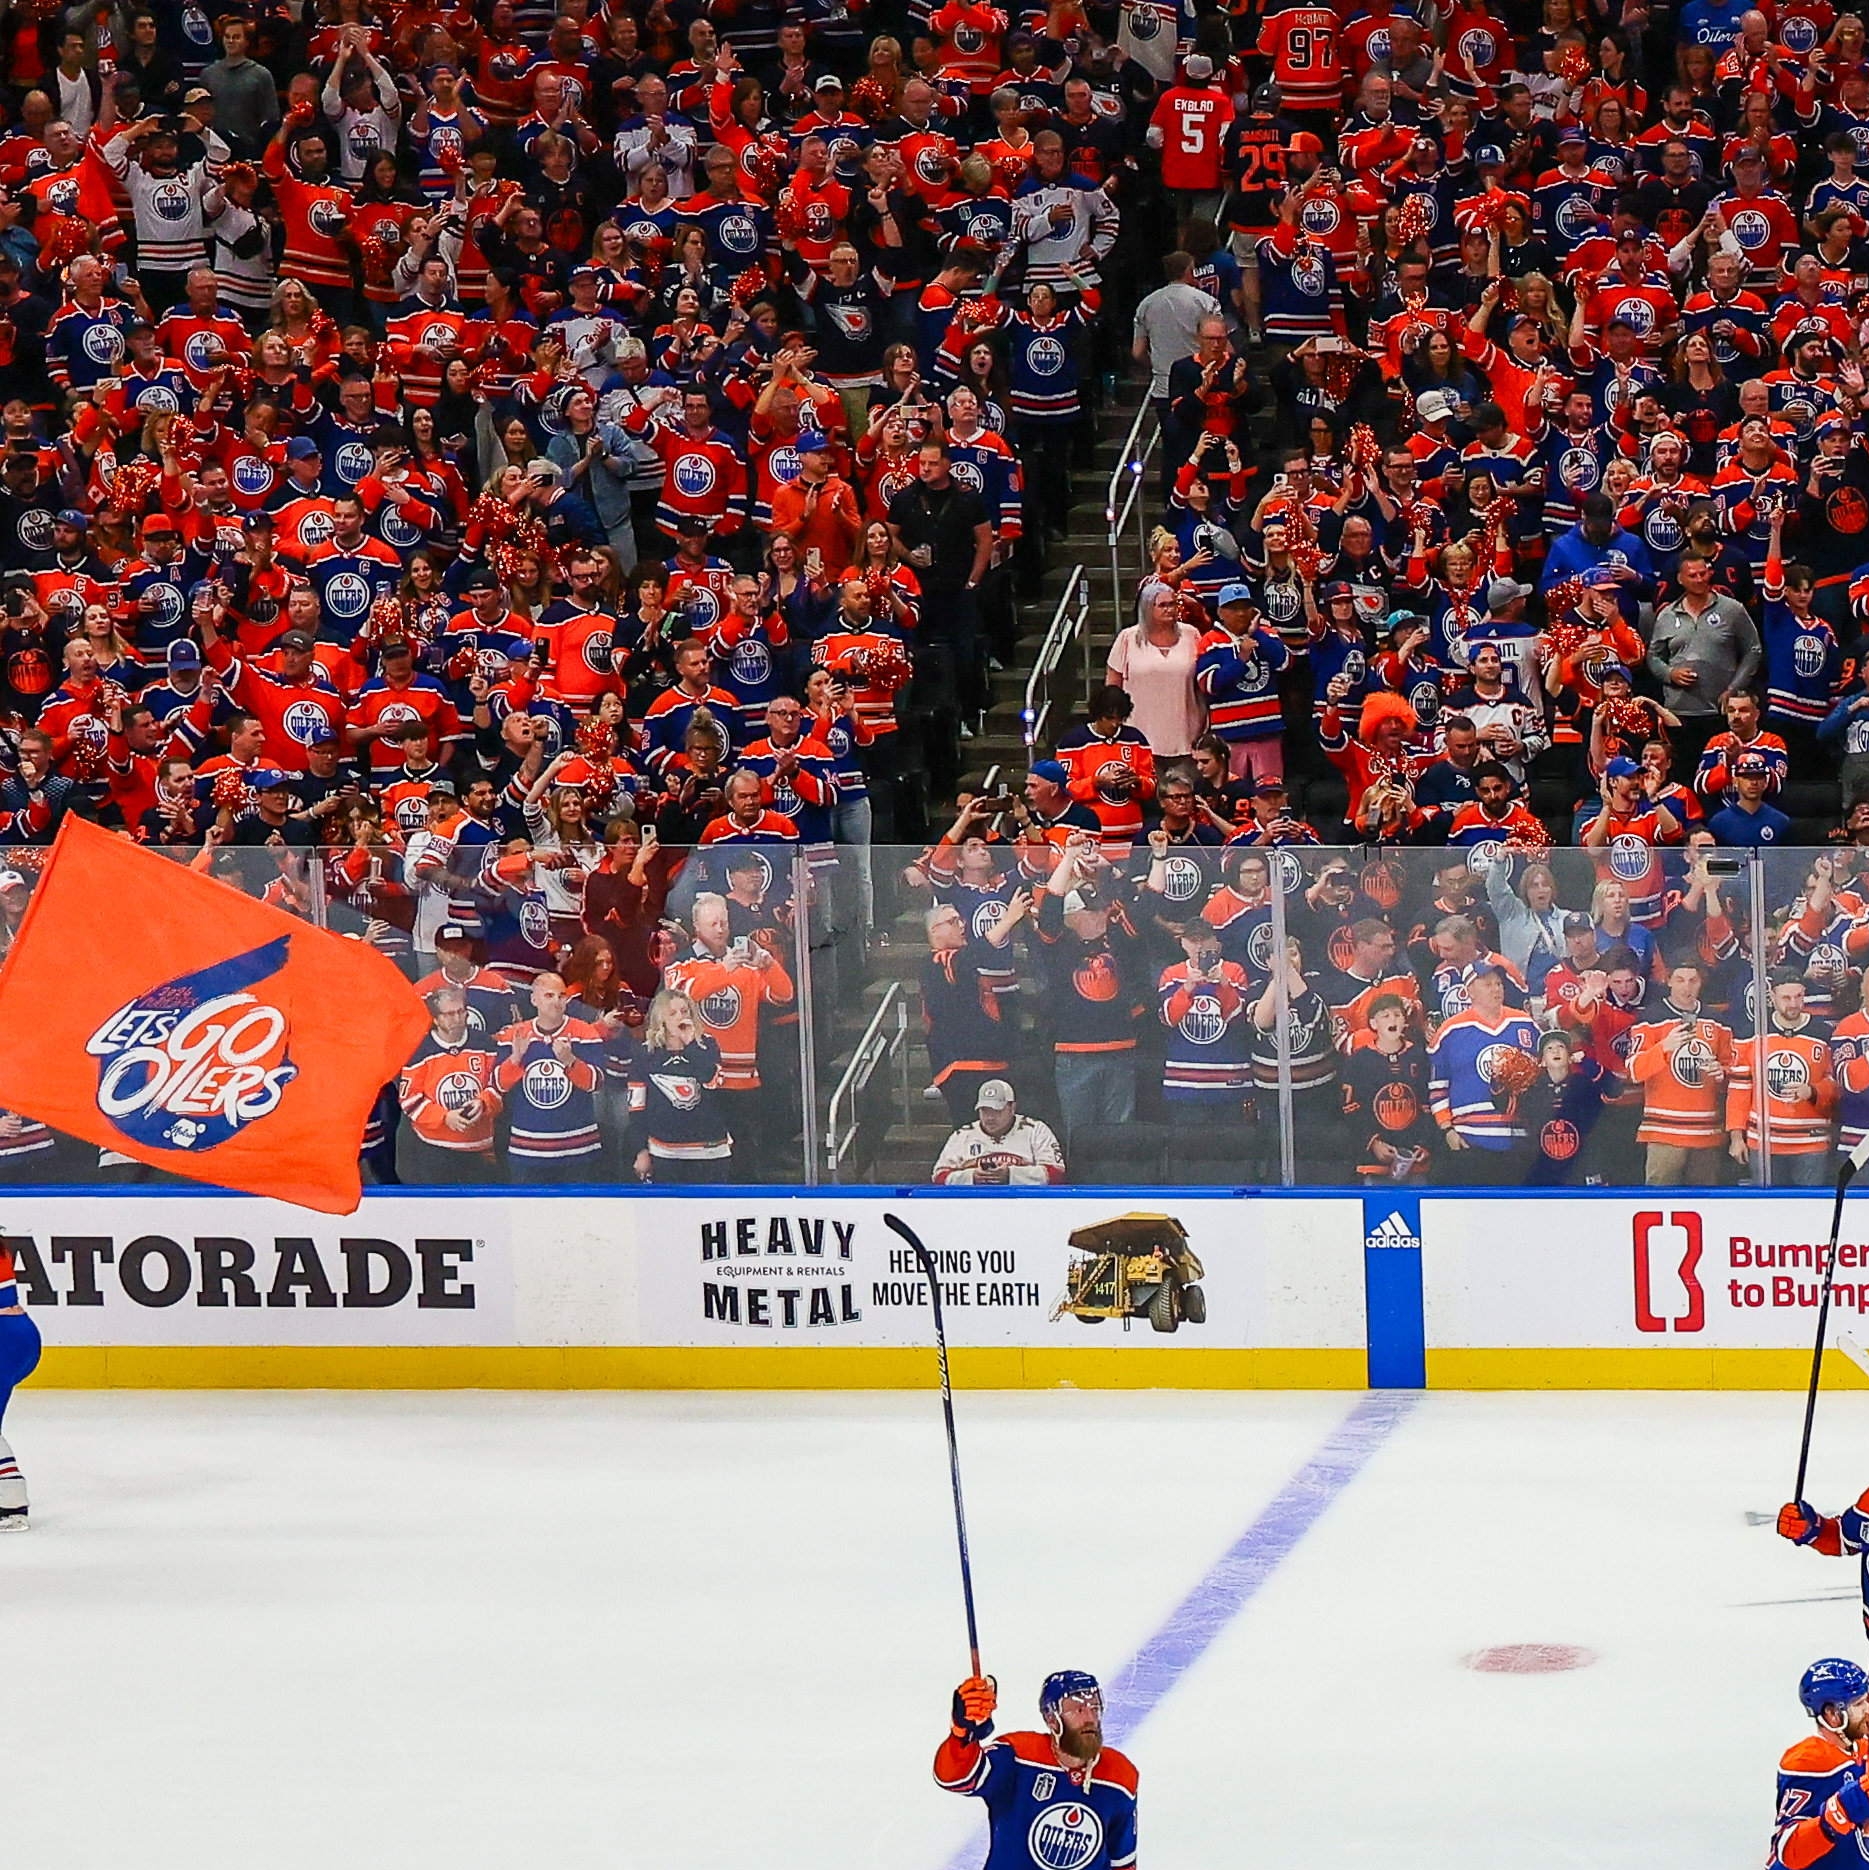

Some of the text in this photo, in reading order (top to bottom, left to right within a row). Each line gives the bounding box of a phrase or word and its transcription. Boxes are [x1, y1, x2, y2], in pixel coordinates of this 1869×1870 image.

[1287, 28, 1330, 68] 97
[1174, 101, 1212, 113] EKBLAD
[1182, 114, 1205, 153] 5
[1239, 145, 1281, 192] 29
[332, 588, 364, 603] OILERS
[291, 714, 328, 728] OILERS
[1613, 851, 1644, 866] OILERS
[1183, 1012, 1222, 1028] OILERS
[1703, 1023, 1713, 1038] C
[87, 990, 287, 1080] LET'S GO
[1813, 1045, 1821, 1060] C
[95, 1047, 297, 1127] OILERS
[530, 1079, 565, 1093] OILERS
[702, 1216, 856, 1262] HEAVY
[1365, 1232, 1421, 1249] adidas
[717, 1266, 845, 1278] EQUIPMENT & RENTALS
[977, 1250, 1015, 1273] YOU
[873, 1283, 926, 1306] MOVE
[977, 1282, 1040, 1306] EARTH
[1729, 1278, 1765, 1307] to
[703, 1282, 862, 1328] METAL
[1038, 1822, 1094, 1856] OILERS
